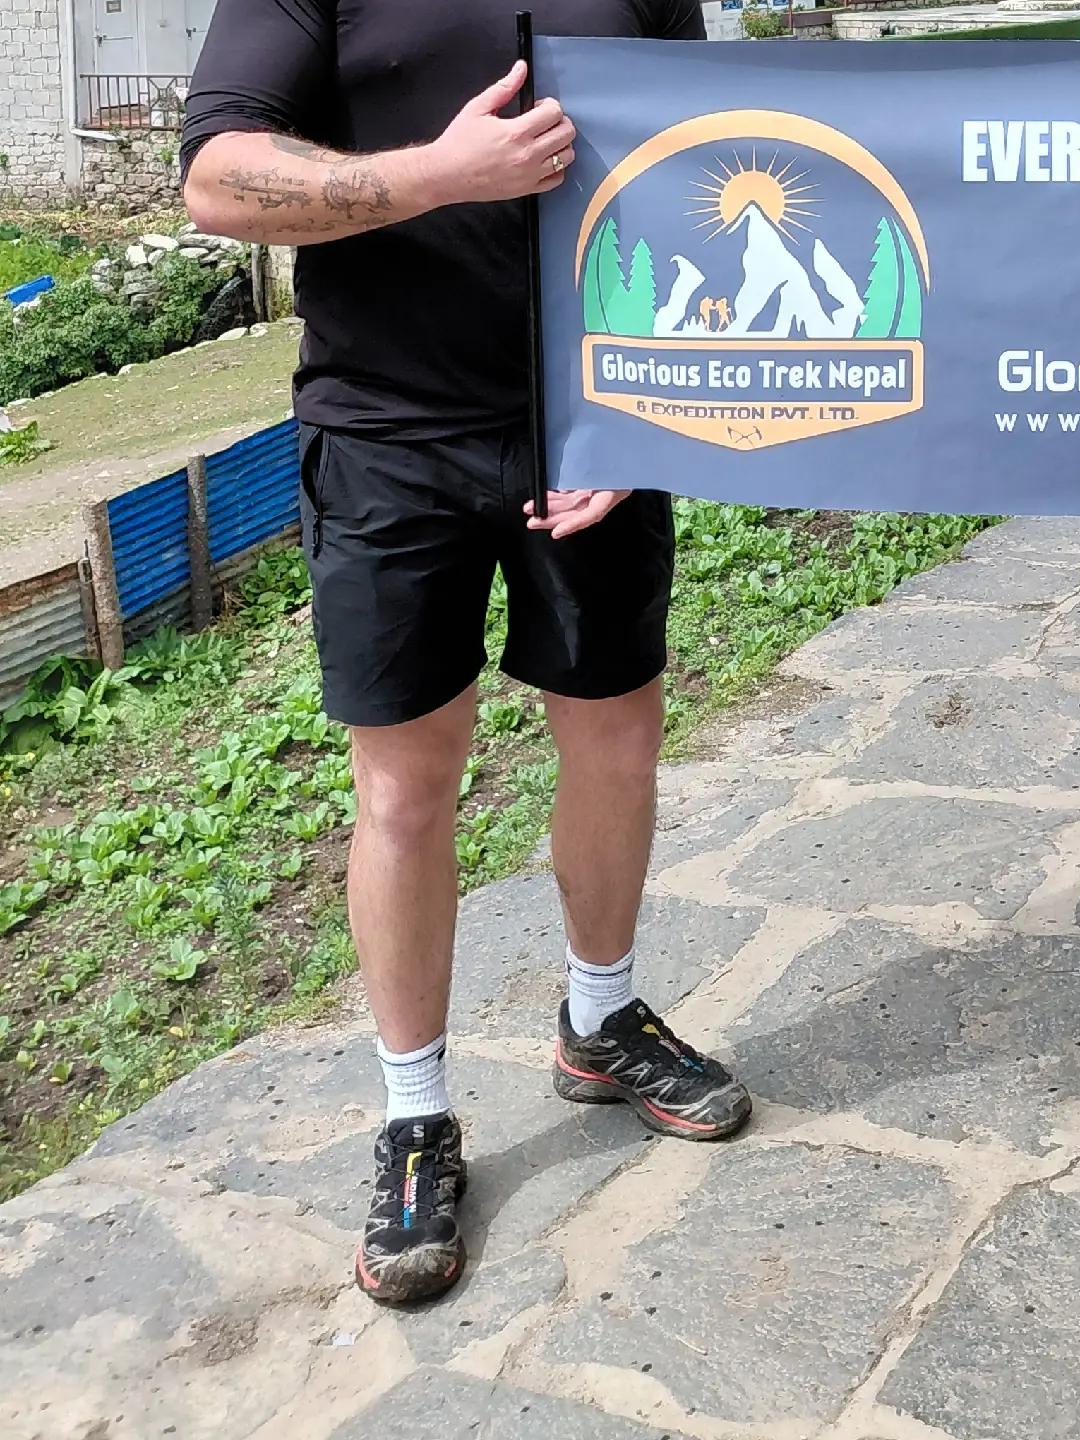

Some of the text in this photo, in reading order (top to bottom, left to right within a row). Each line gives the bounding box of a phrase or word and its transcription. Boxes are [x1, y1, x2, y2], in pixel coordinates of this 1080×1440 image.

[601, 353, 907, 397] Glorious Eco Trek Nepal
[651, 401, 765, 420] EXPEDITION
[770, 406, 813, 420] PVT.
[819, 406, 860, 420] LTD.
